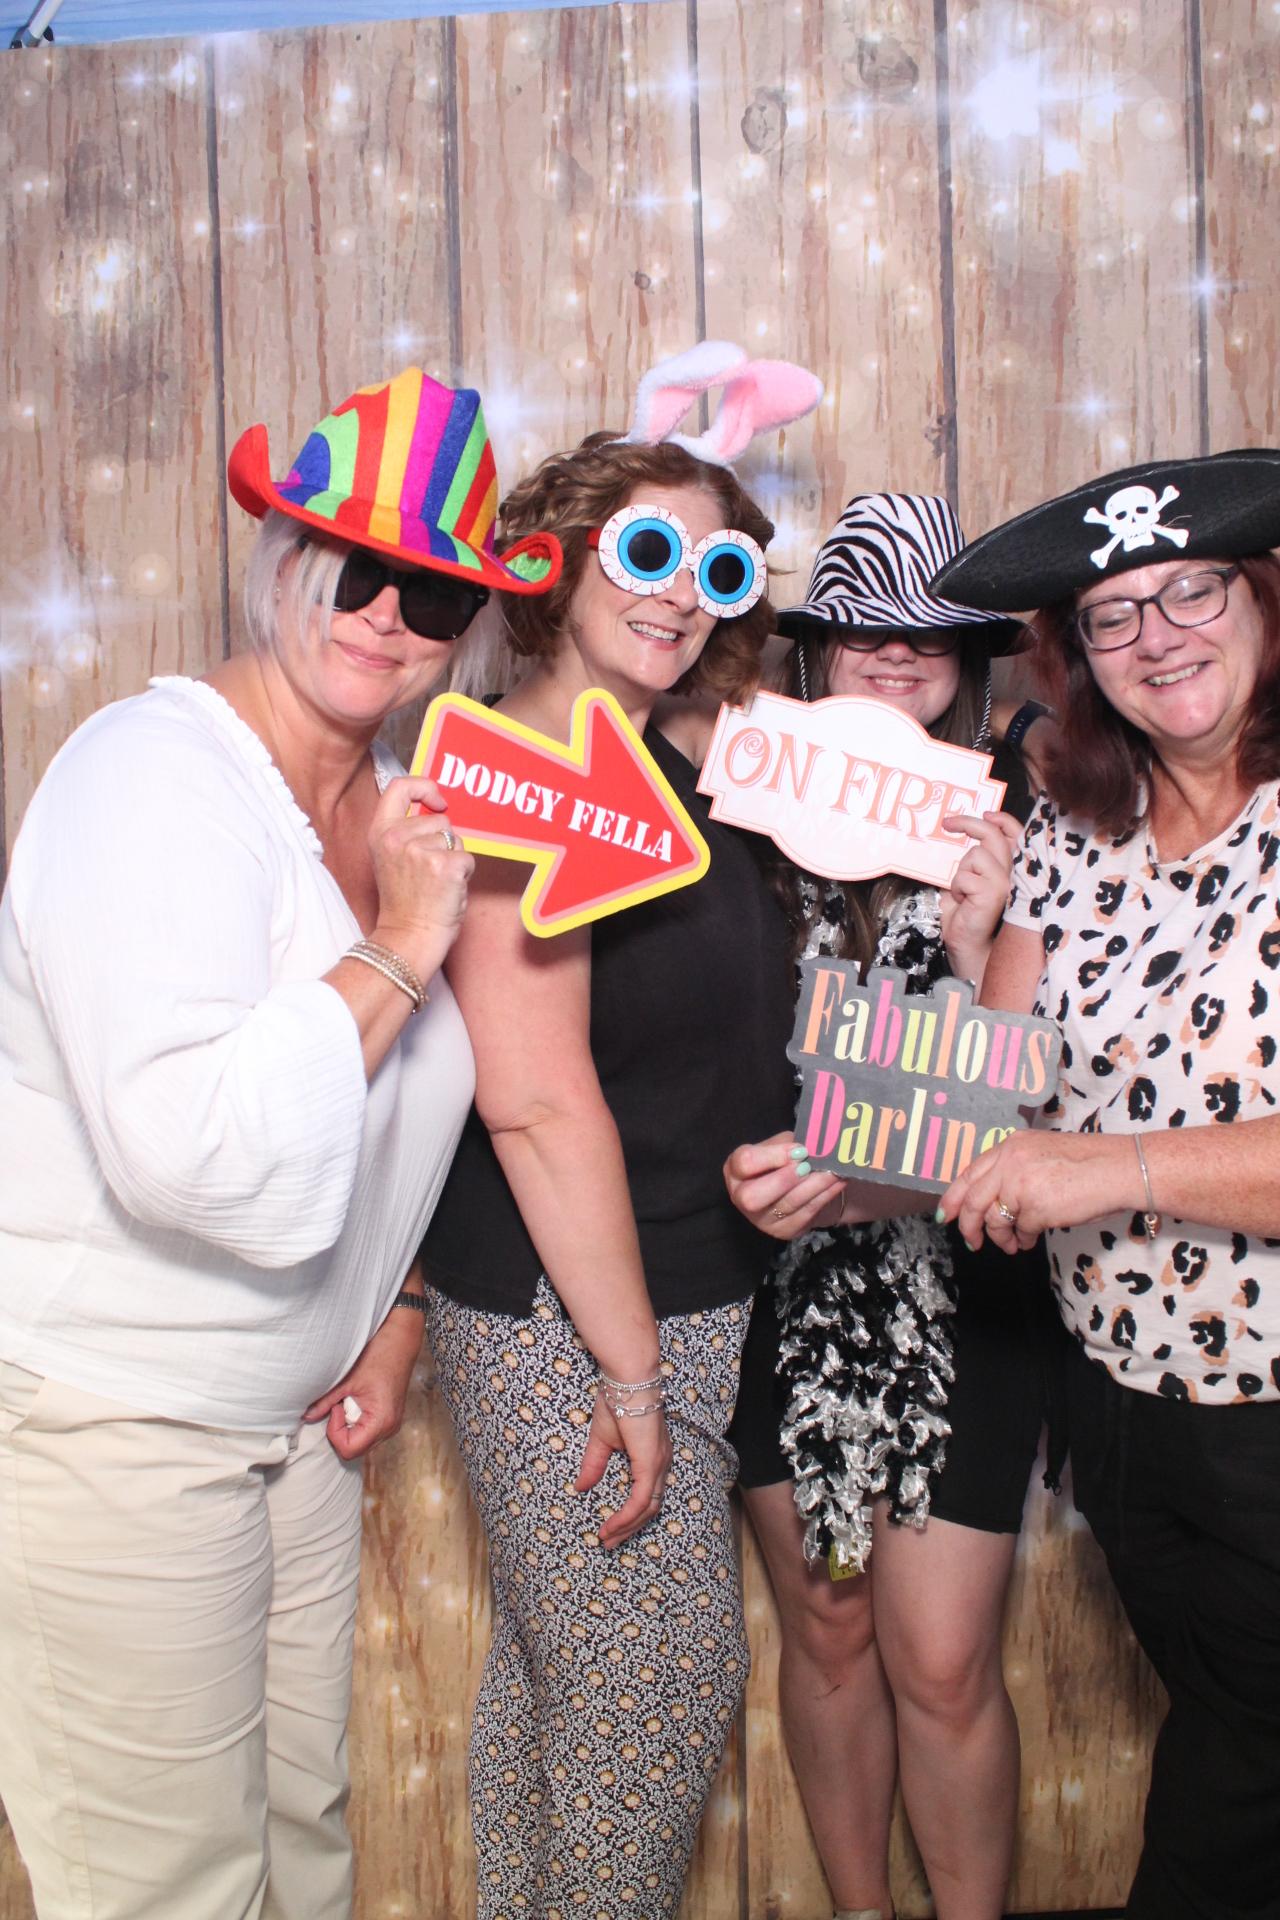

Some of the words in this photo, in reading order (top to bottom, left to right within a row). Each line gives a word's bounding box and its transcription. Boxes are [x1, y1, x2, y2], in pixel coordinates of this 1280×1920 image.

[437, 753, 565, 822] DODGY
[568, 799, 672, 863] FELLA
[724, 727, 827, 803] ON
[828, 750, 980, 848] FIRE
[799, 968, 1053, 1095] Fabulous
